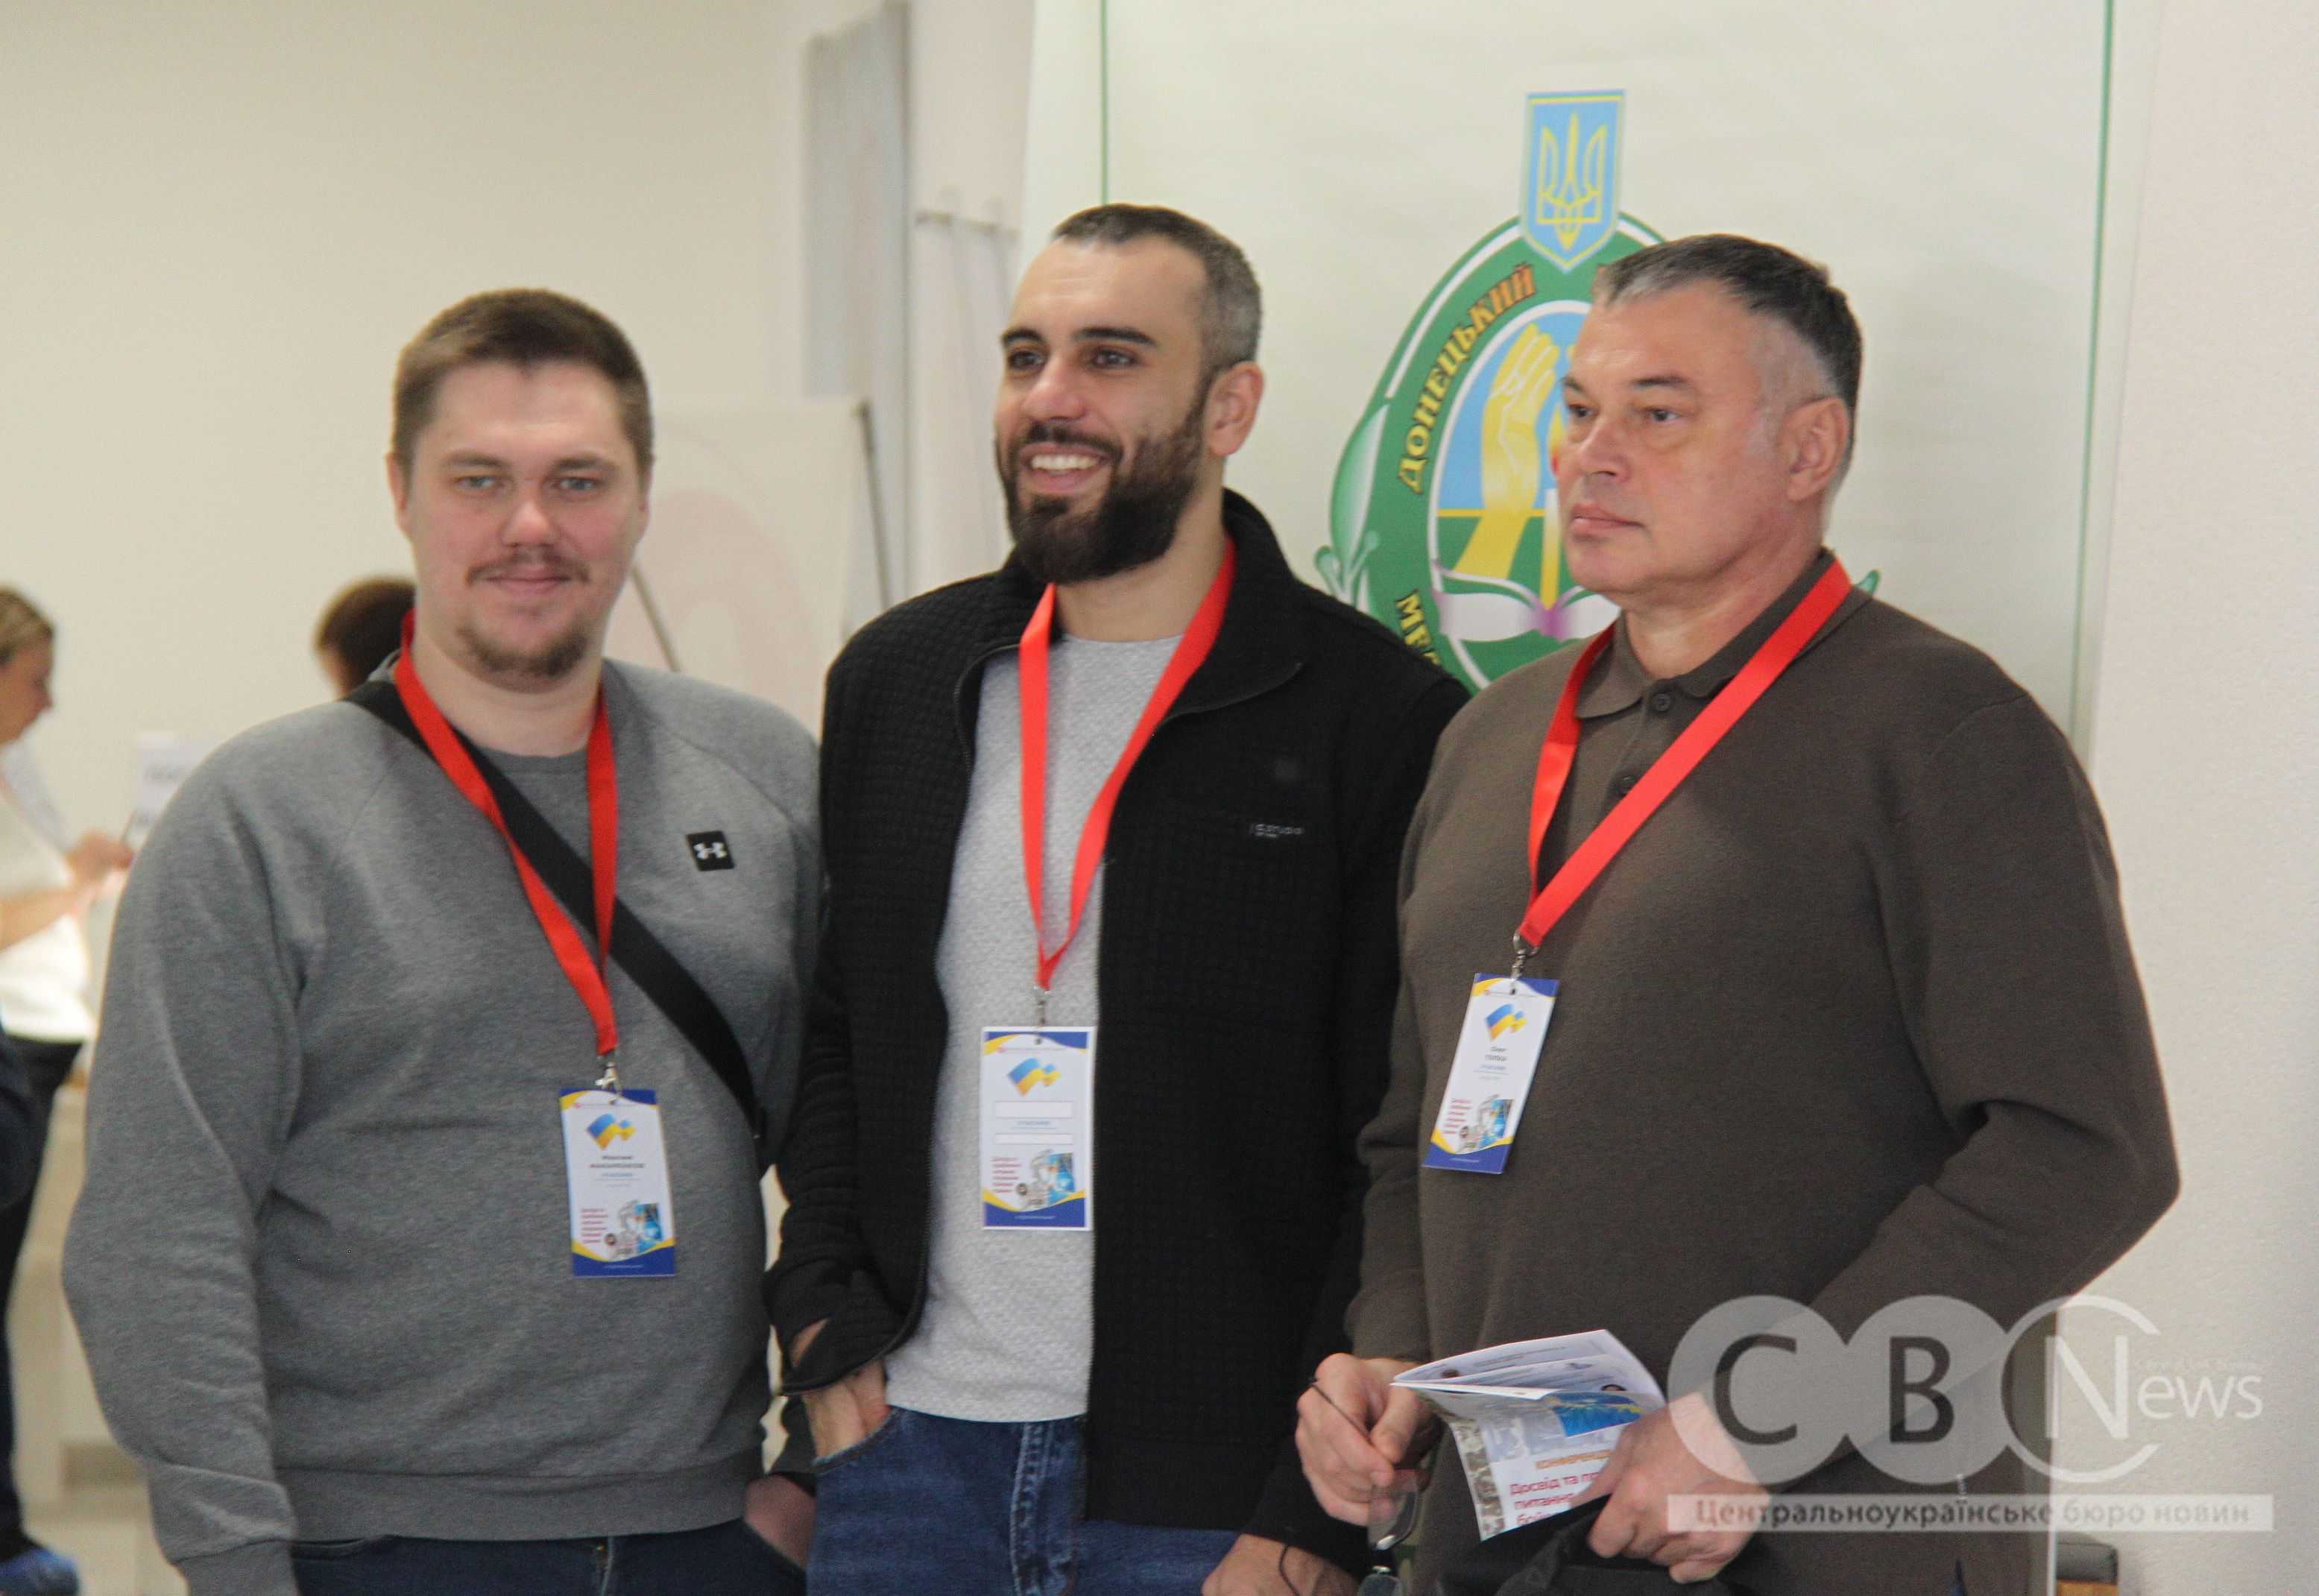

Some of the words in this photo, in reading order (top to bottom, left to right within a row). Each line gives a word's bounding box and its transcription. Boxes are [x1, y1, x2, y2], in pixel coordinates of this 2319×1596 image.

[1397, 262, 1537, 495] ДОНЕЦЬКИЙ
[1509, 1477, 1560, 1497] Досвід
[1562, 1474, 1579, 1486] та
